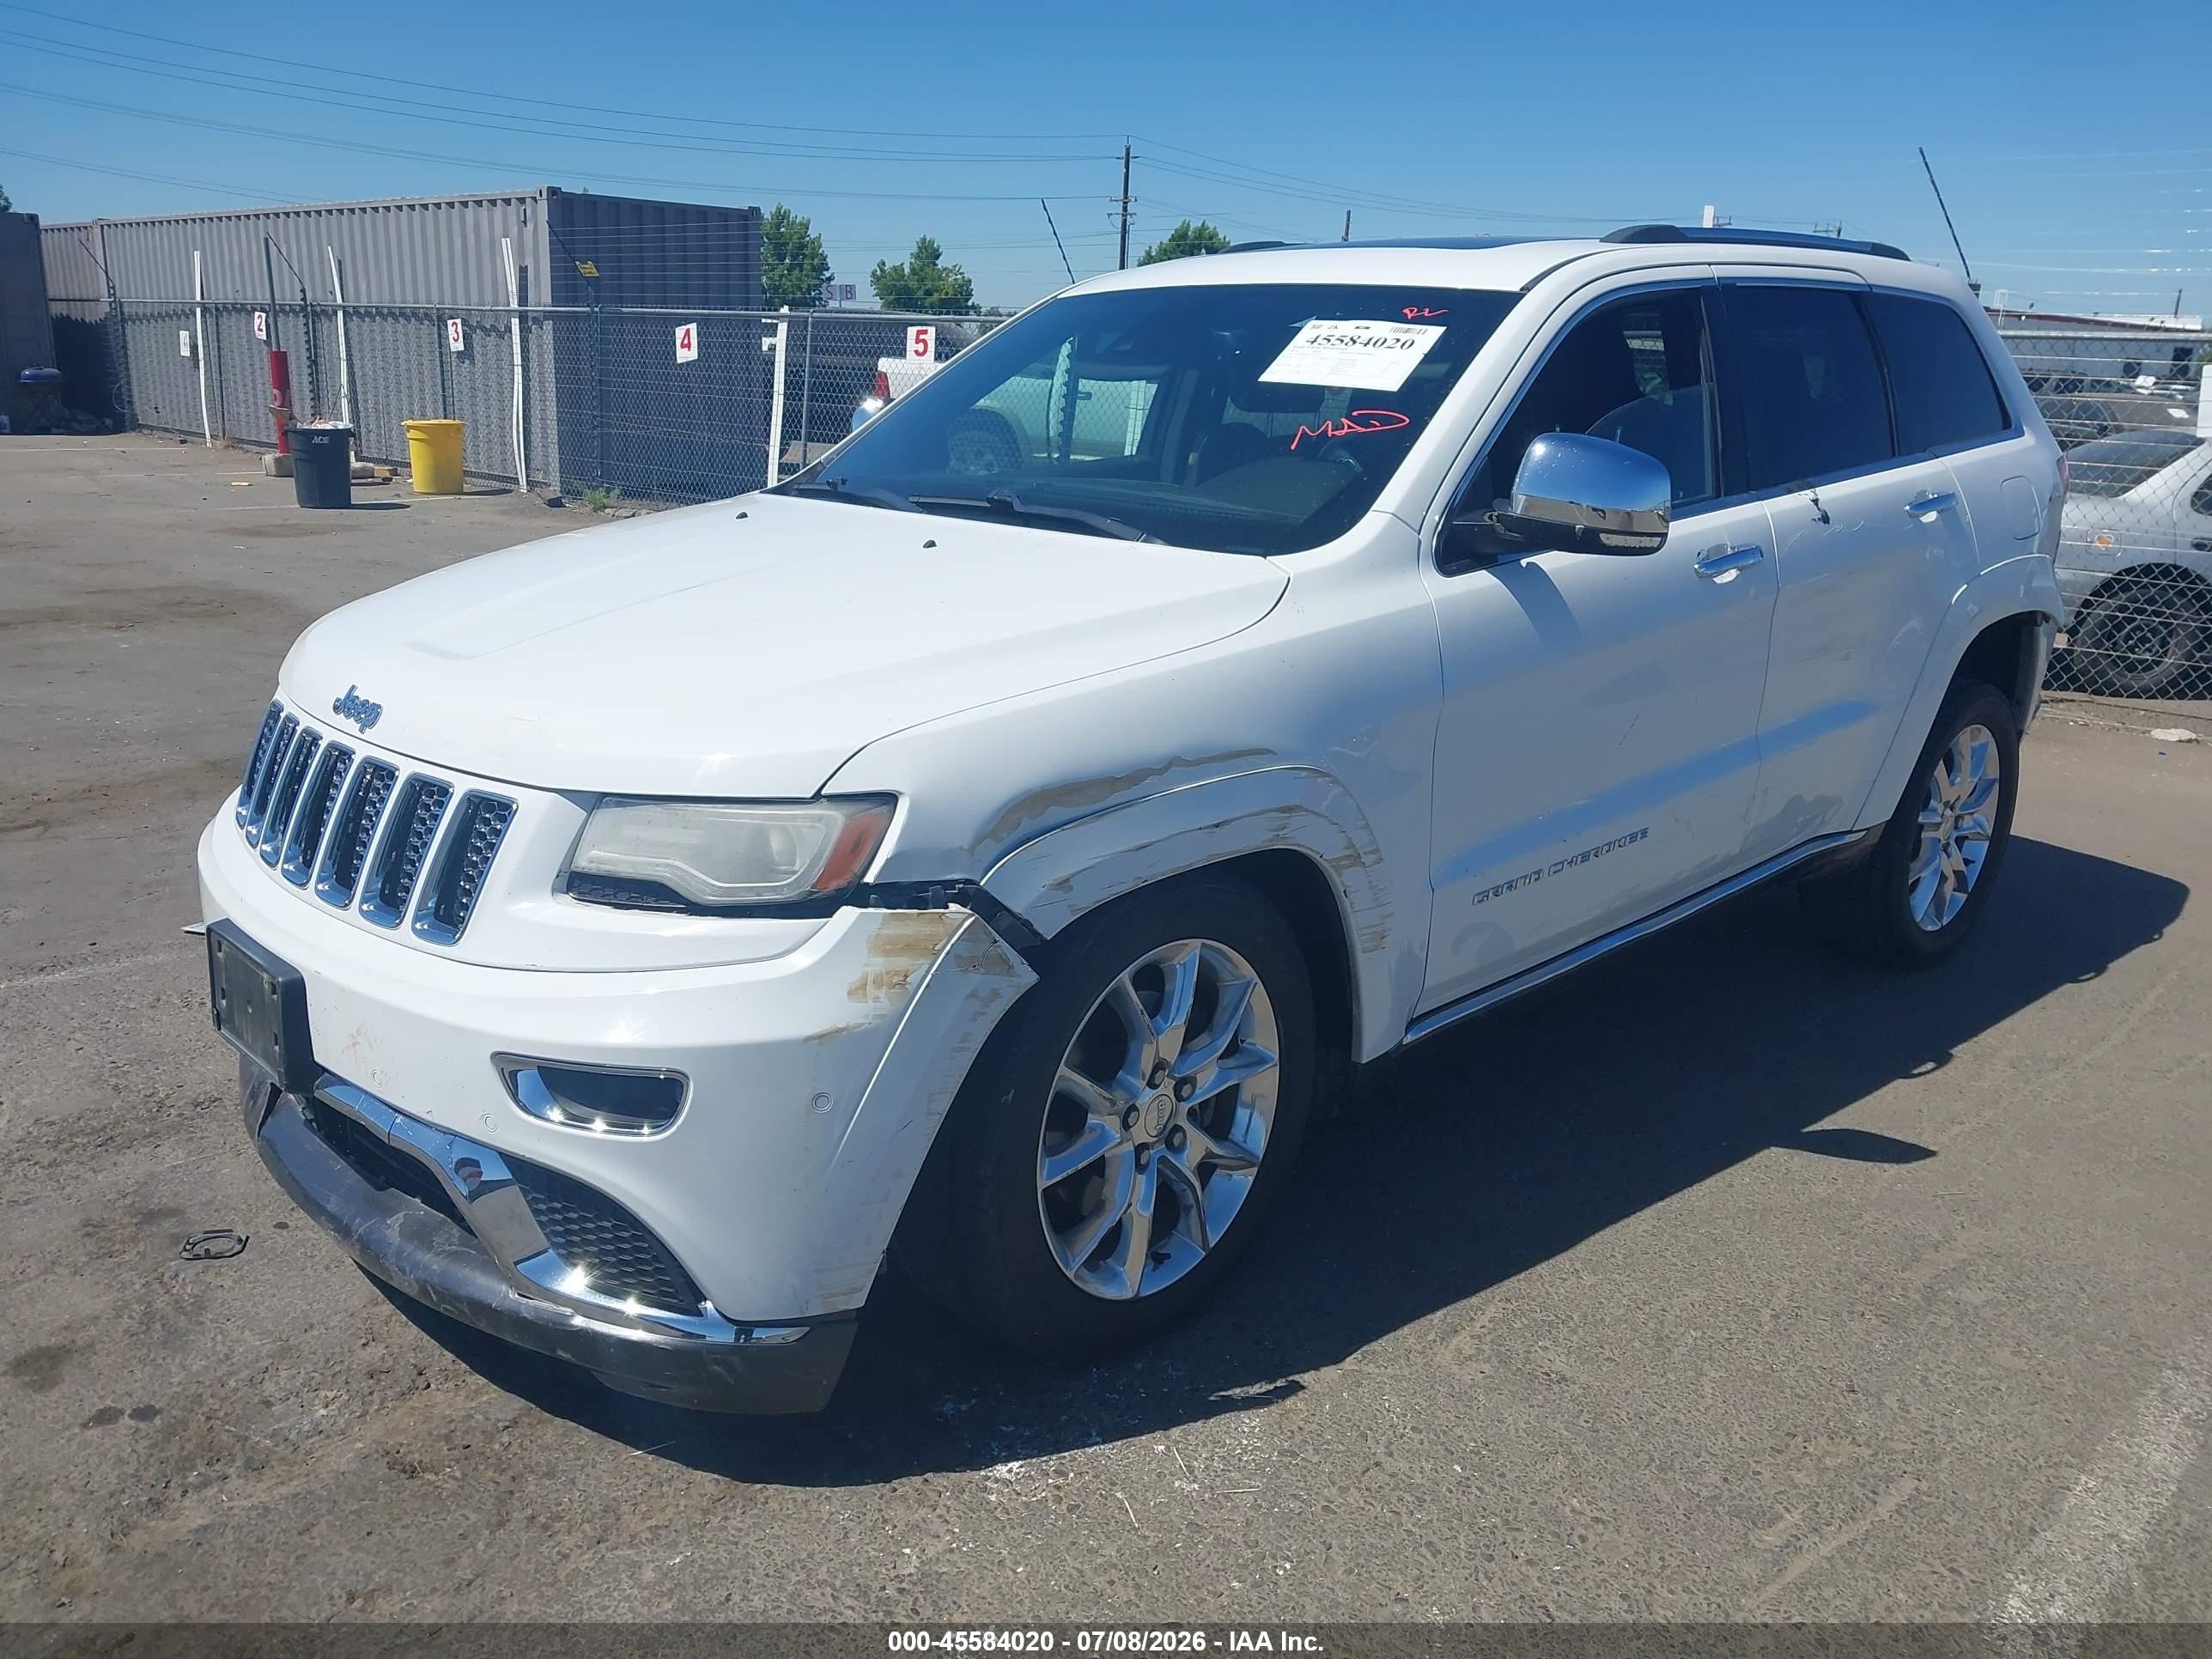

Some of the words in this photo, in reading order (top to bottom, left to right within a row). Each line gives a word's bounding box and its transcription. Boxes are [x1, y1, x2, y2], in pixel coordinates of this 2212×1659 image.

[257, 313, 264, 333] 2
[451, 321, 460, 343] 3
[679, 328, 692, 352] 4
[913, 329, 929, 358] 5
[1305, 333, 1415, 350] 45584020
[312, 435, 331, 444] ACE
[333, 684, 383, 734] Jeep
[1472, 868, 1545, 906] GRAND
[1547, 827, 1650, 877] CHEROKEE
